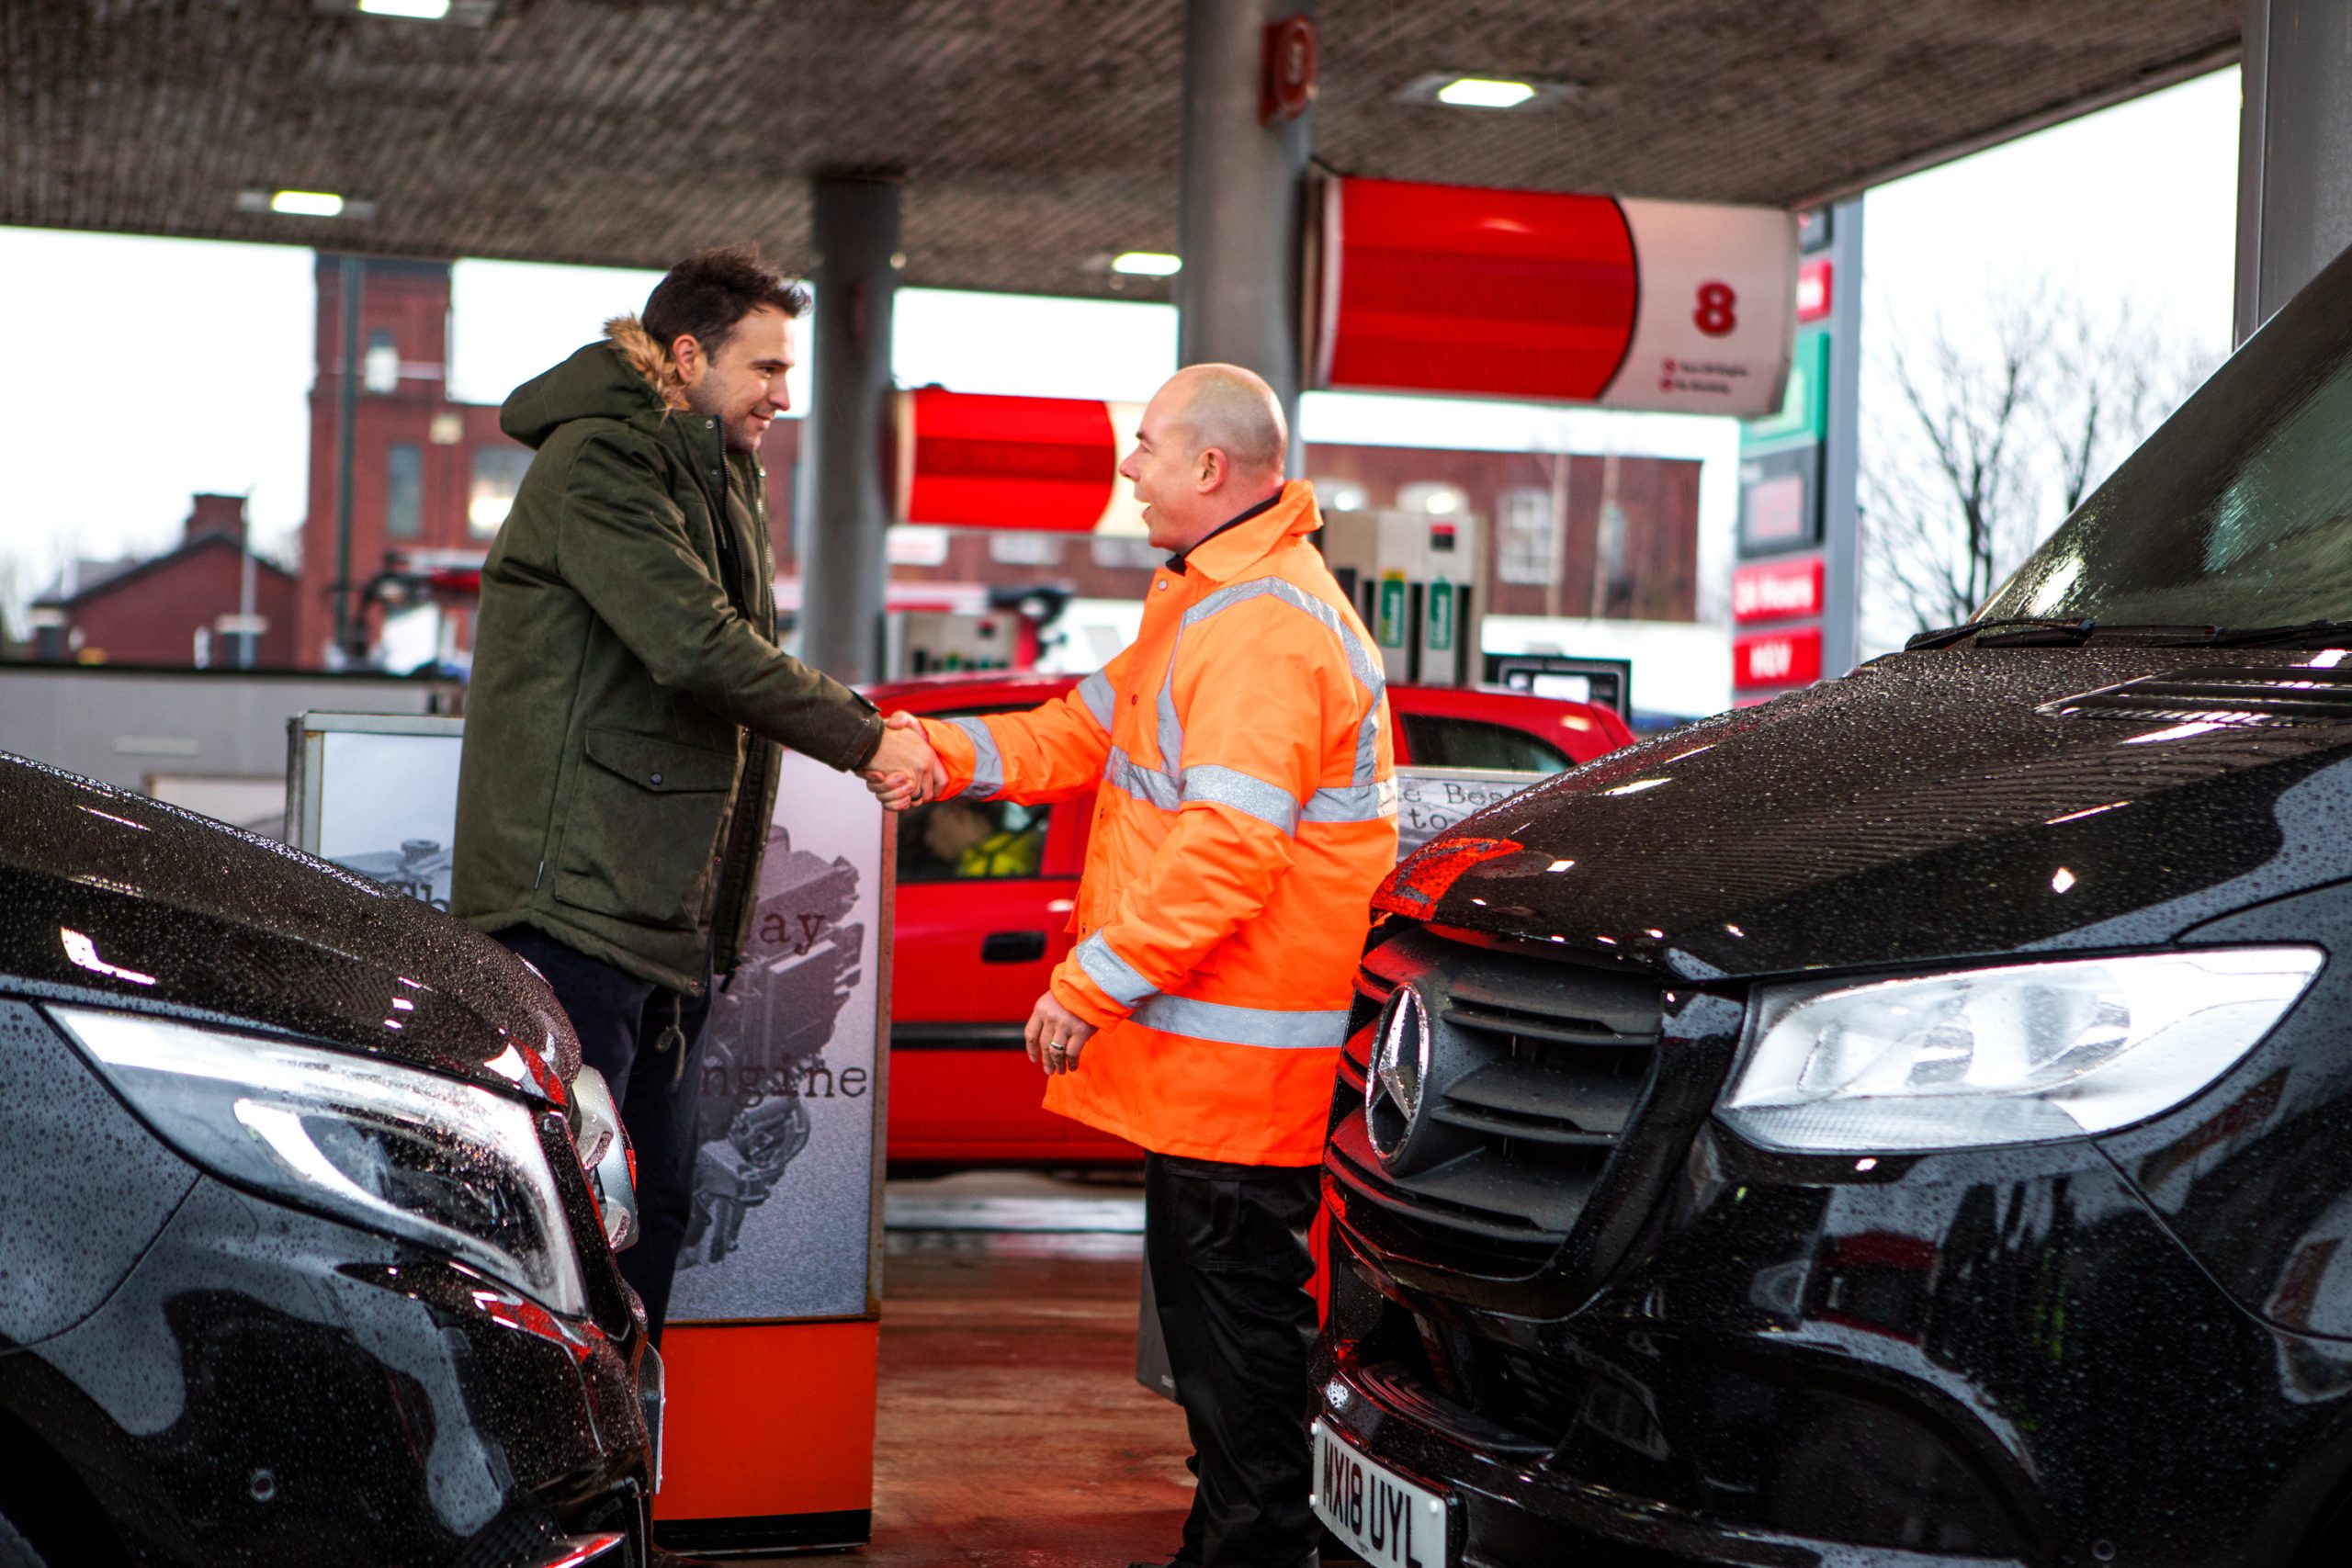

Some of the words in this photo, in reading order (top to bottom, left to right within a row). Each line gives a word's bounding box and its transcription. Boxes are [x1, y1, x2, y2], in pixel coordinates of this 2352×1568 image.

[1693, 280, 1737, 338] 8
[1408, 807, 1448, 830] to
[759, 913, 829, 956] ay
[701, 1052, 867, 1108] ngine
[1323, 1436, 1363, 1537] MX18
[1370, 1473, 1423, 1567] UYL
